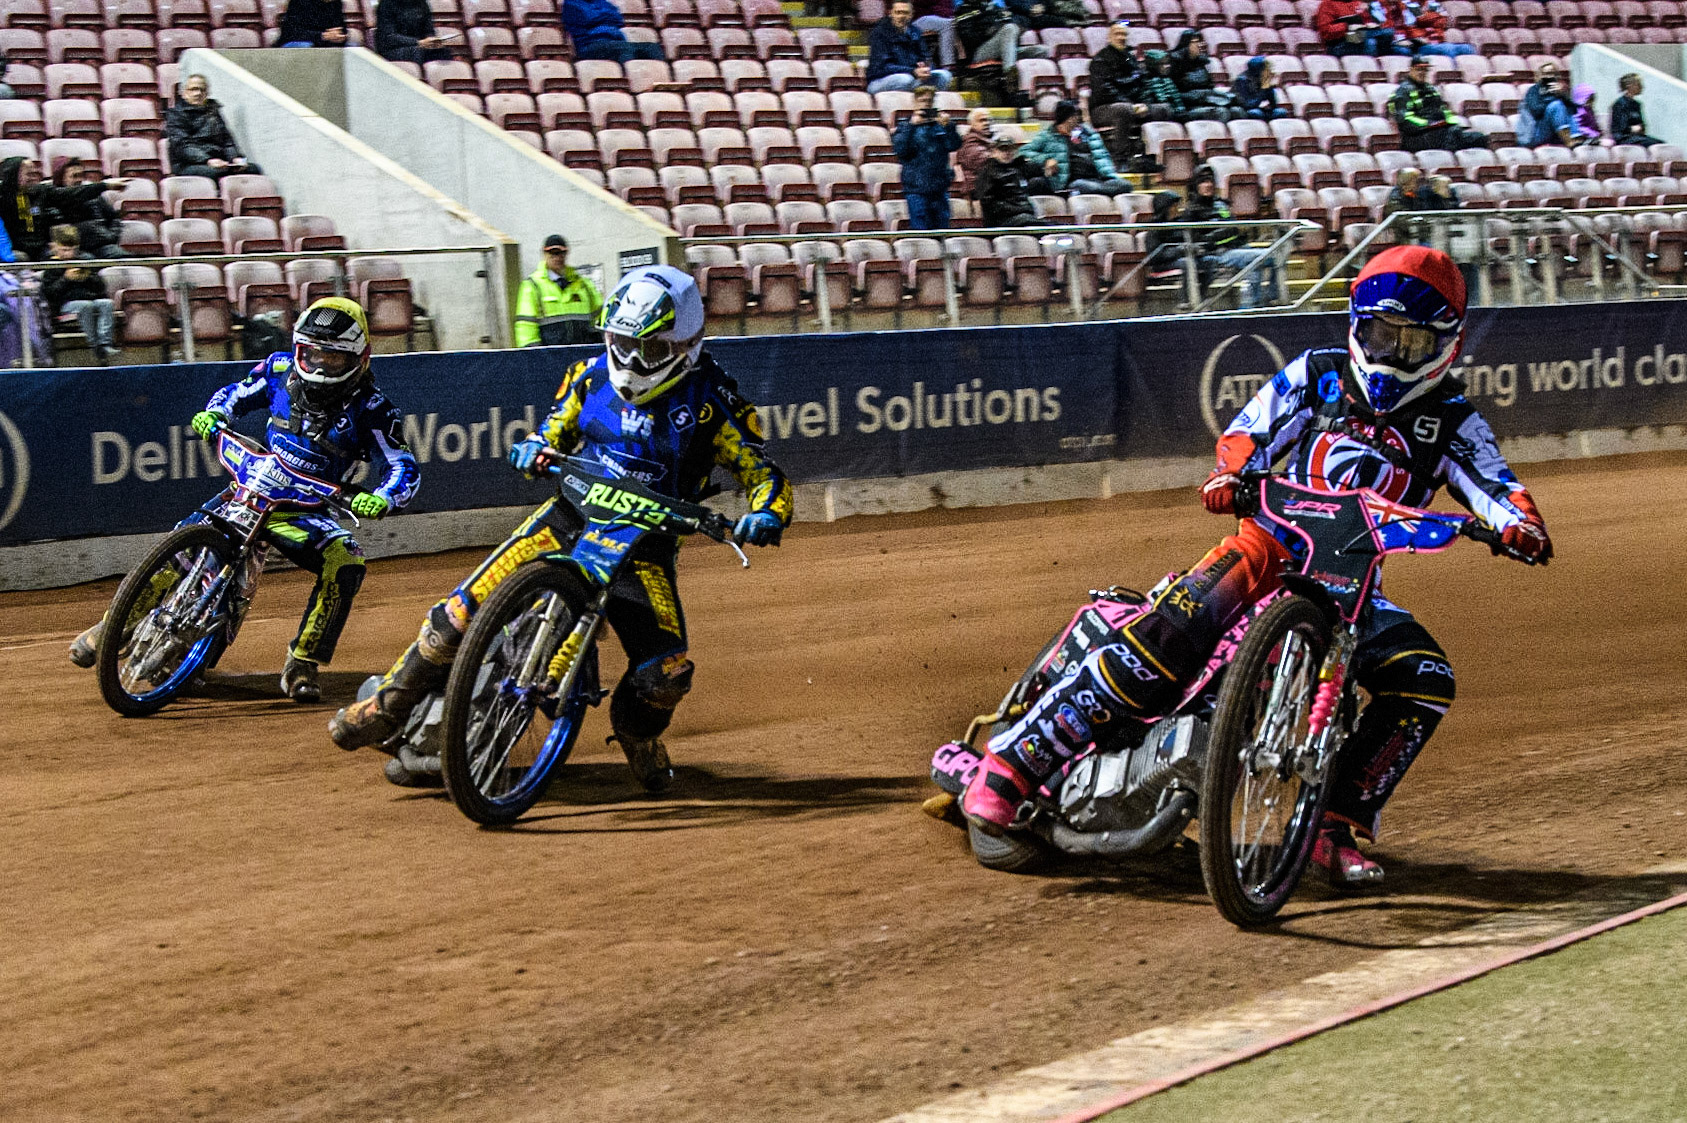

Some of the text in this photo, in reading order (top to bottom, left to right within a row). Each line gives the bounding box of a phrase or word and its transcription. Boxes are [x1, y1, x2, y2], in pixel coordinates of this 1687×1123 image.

[1527, 345, 1625, 392] world
[336, 417, 348, 429] 3
[402, 404, 536, 464] World
[856, 378, 1062, 434] Solutions
[675, 411, 689, 426] 5
[272, 443, 319, 471] CHARGERS
[601, 453, 654, 484] CHARGERS
[585, 482, 672, 525] RUSTY
[1110, 643, 1159, 681] pod
